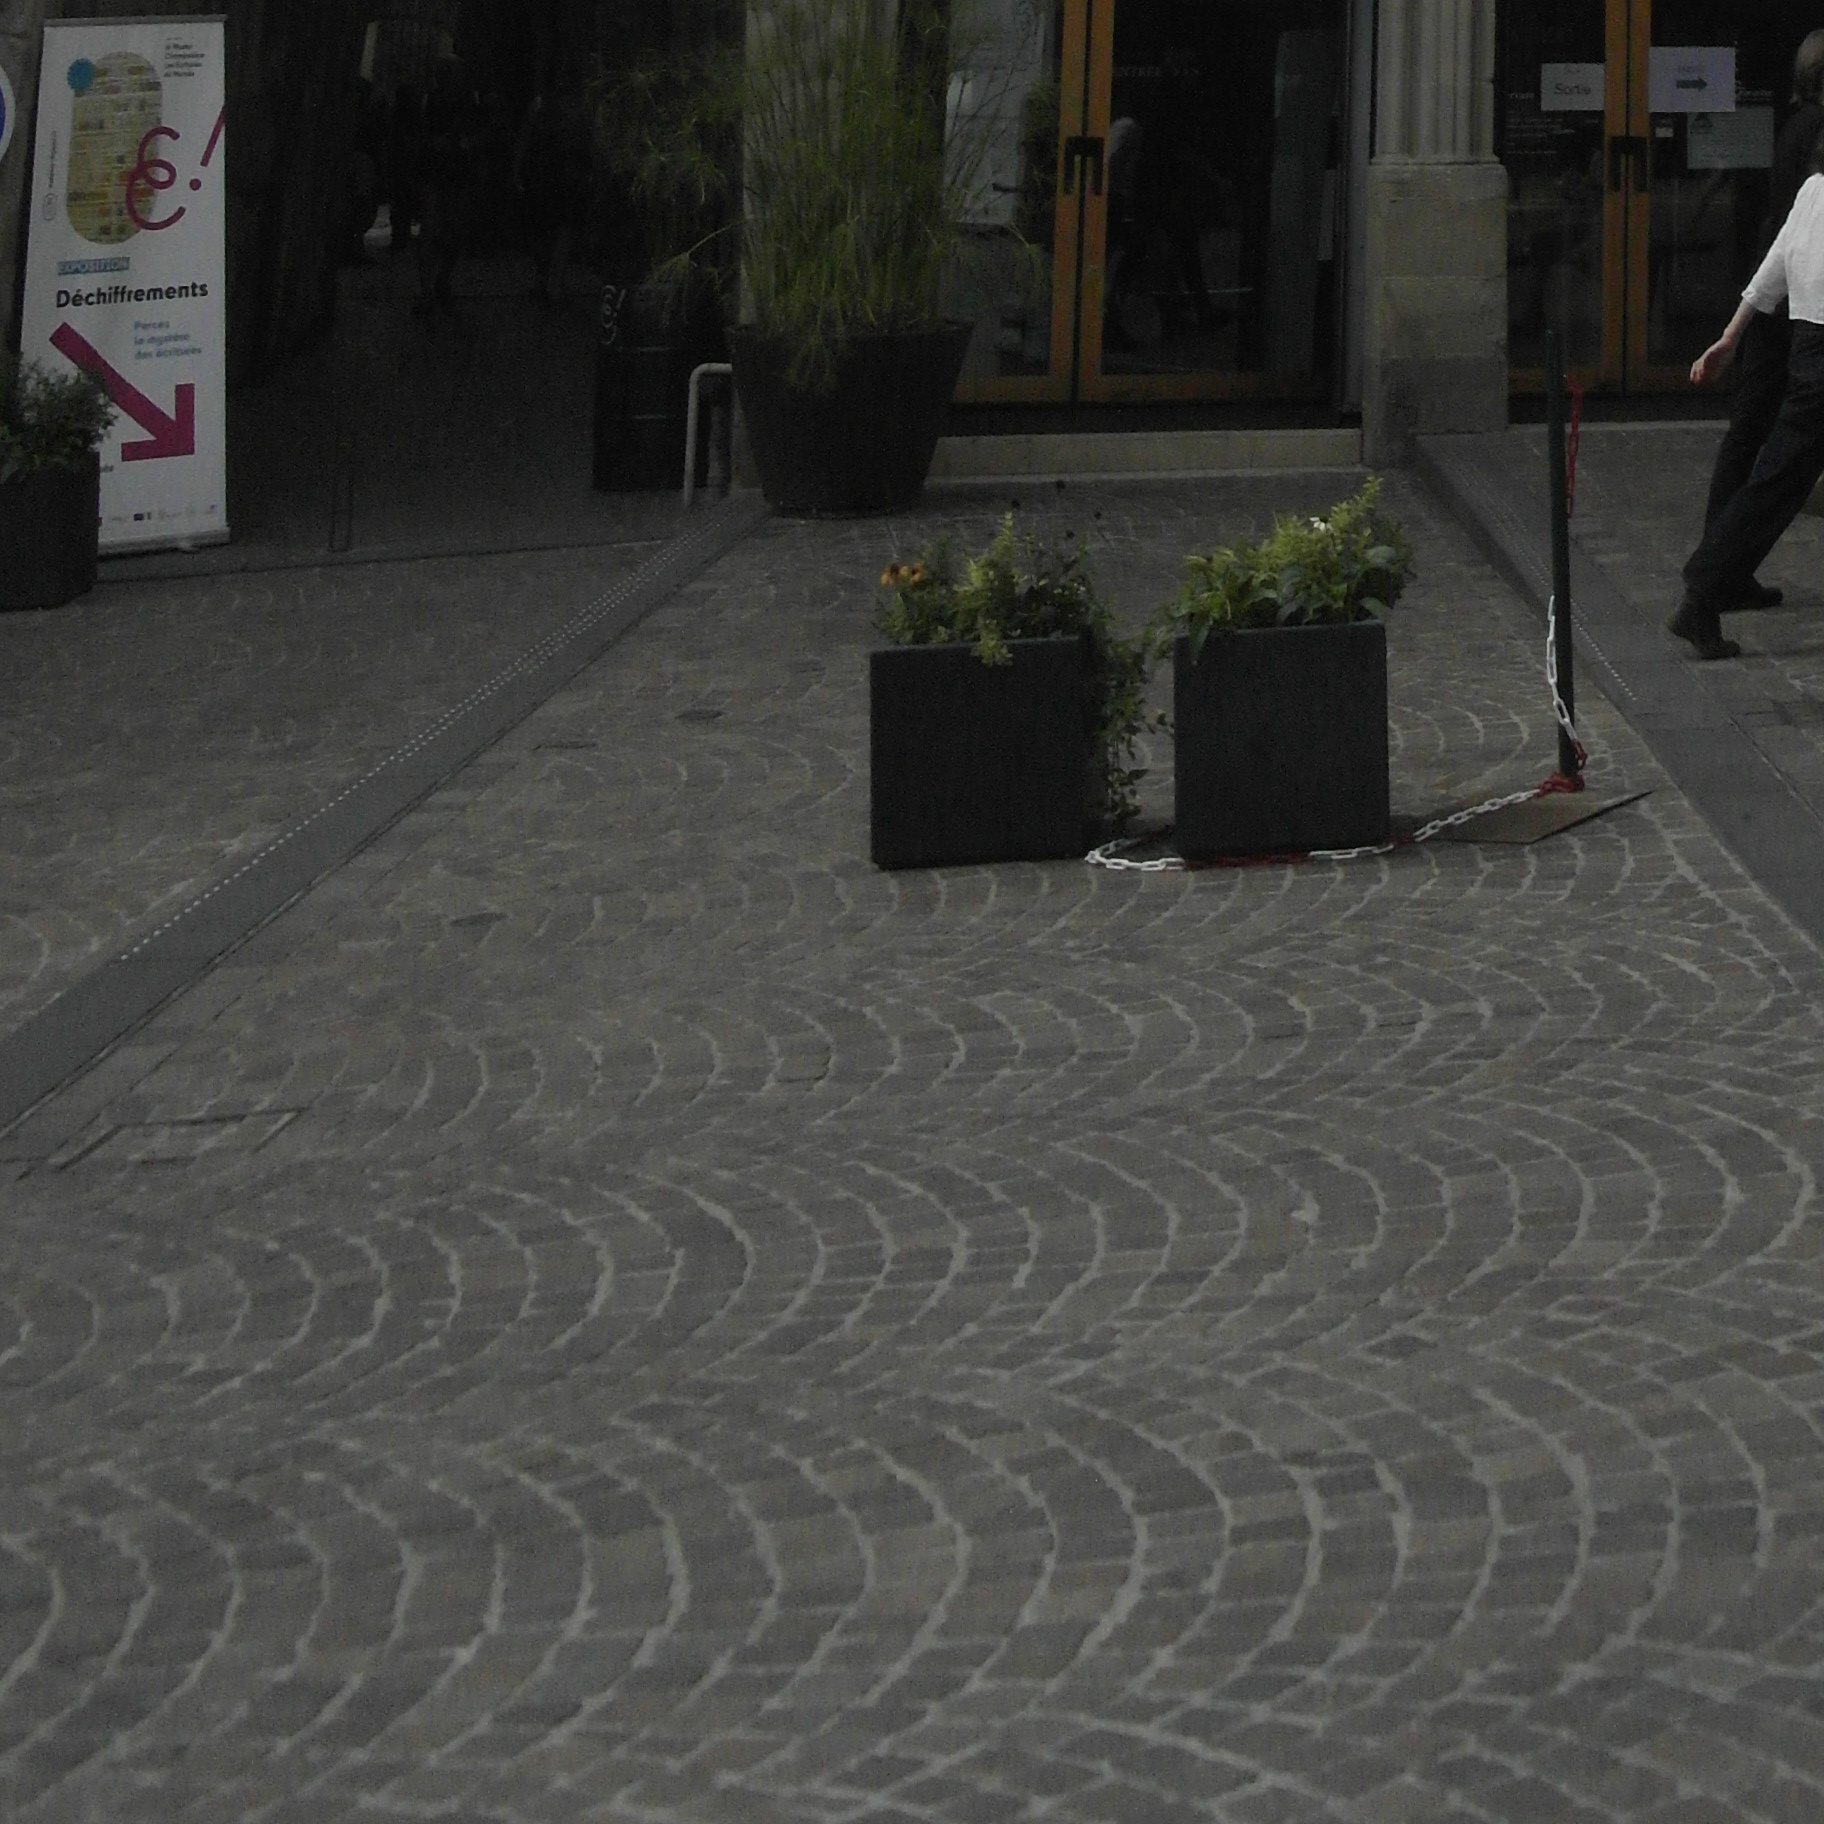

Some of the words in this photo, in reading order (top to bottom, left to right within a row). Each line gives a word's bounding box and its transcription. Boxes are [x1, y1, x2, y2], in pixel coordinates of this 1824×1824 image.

[1554, 83, 1592, 95] Sortie
[57, 257, 130, 275] EXPOSITION
[56, 282, 209, 308] Déchiffrements
